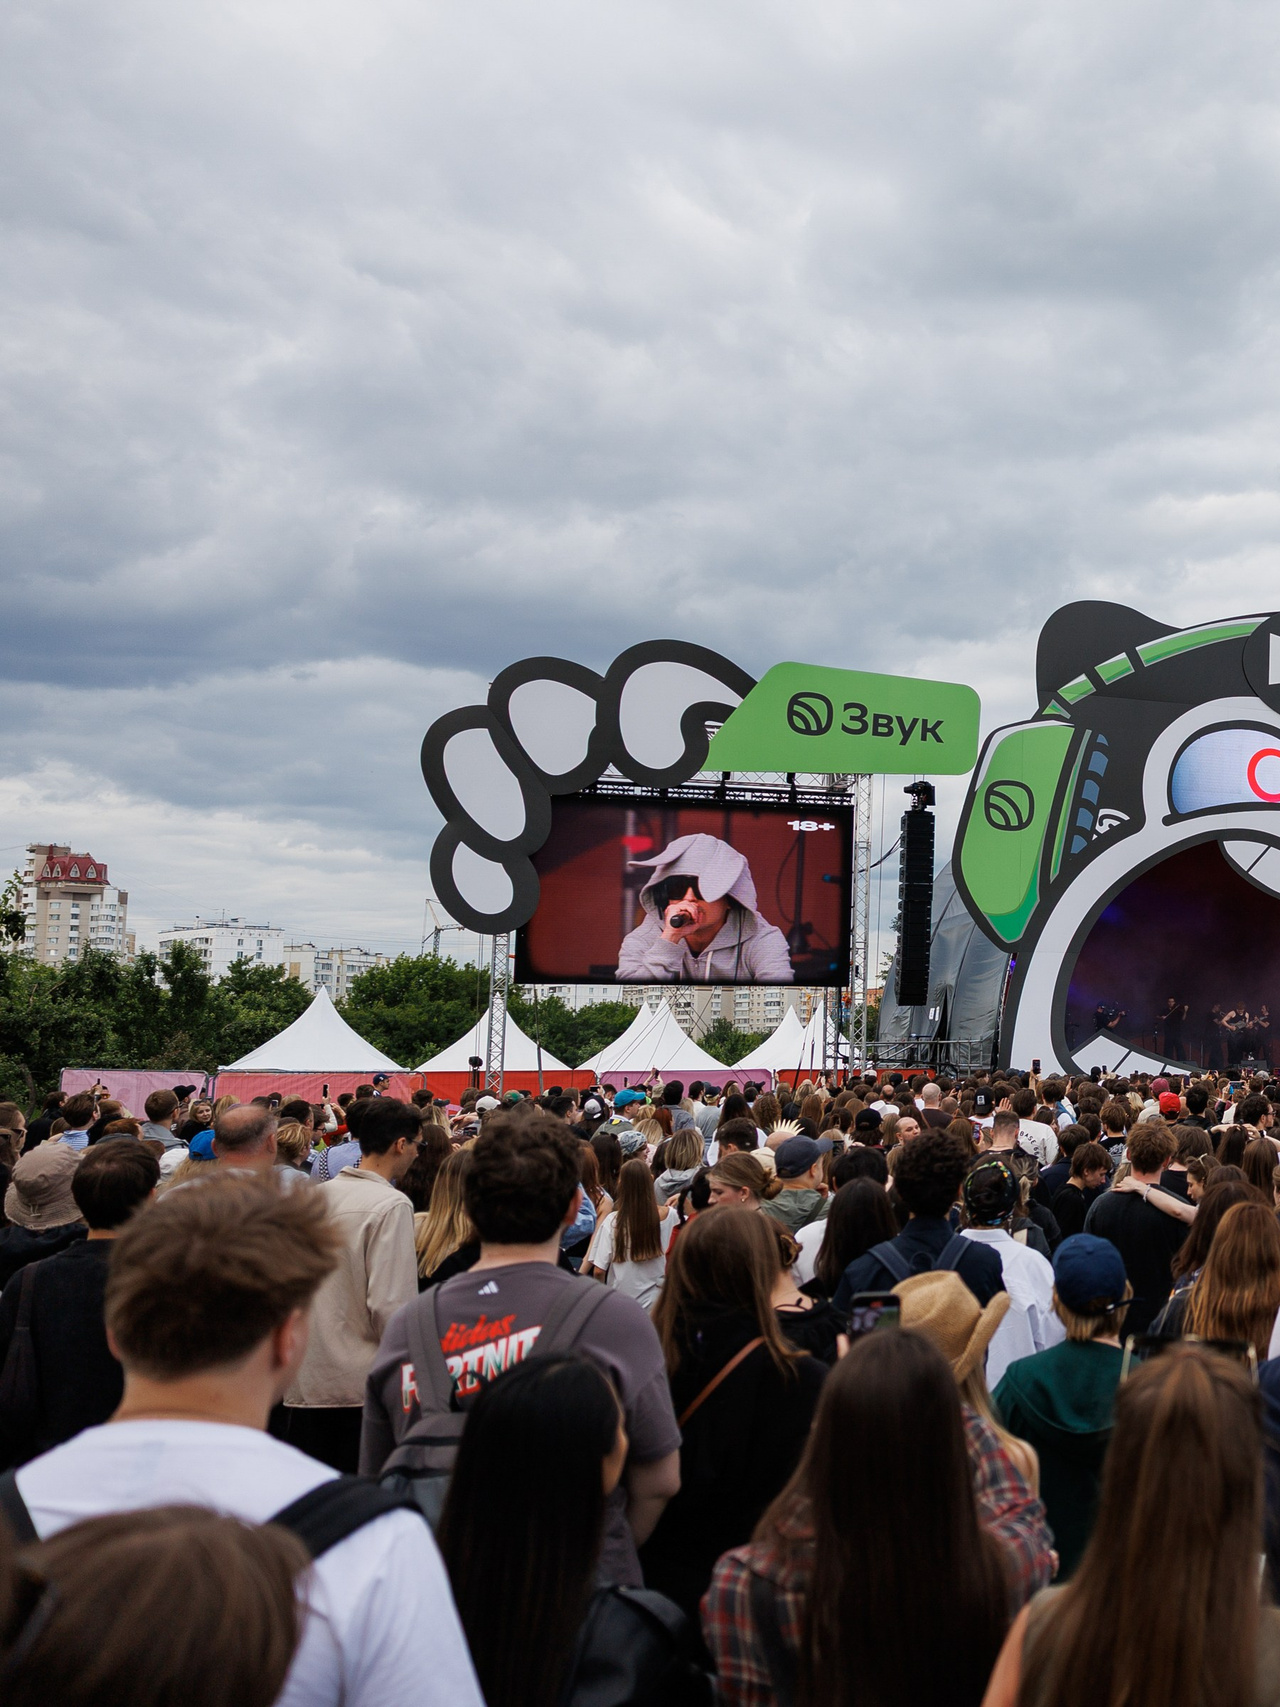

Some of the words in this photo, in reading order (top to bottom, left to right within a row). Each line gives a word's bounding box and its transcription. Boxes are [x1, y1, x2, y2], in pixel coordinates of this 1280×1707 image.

[841, 702, 945, 746] Звук
[787, 820, 835, 831] 18+
[1019, 1130, 1037, 1145] BASE
[440, 1313, 518, 1353] didas
[402, 1325, 542, 1412] FRTNIT
